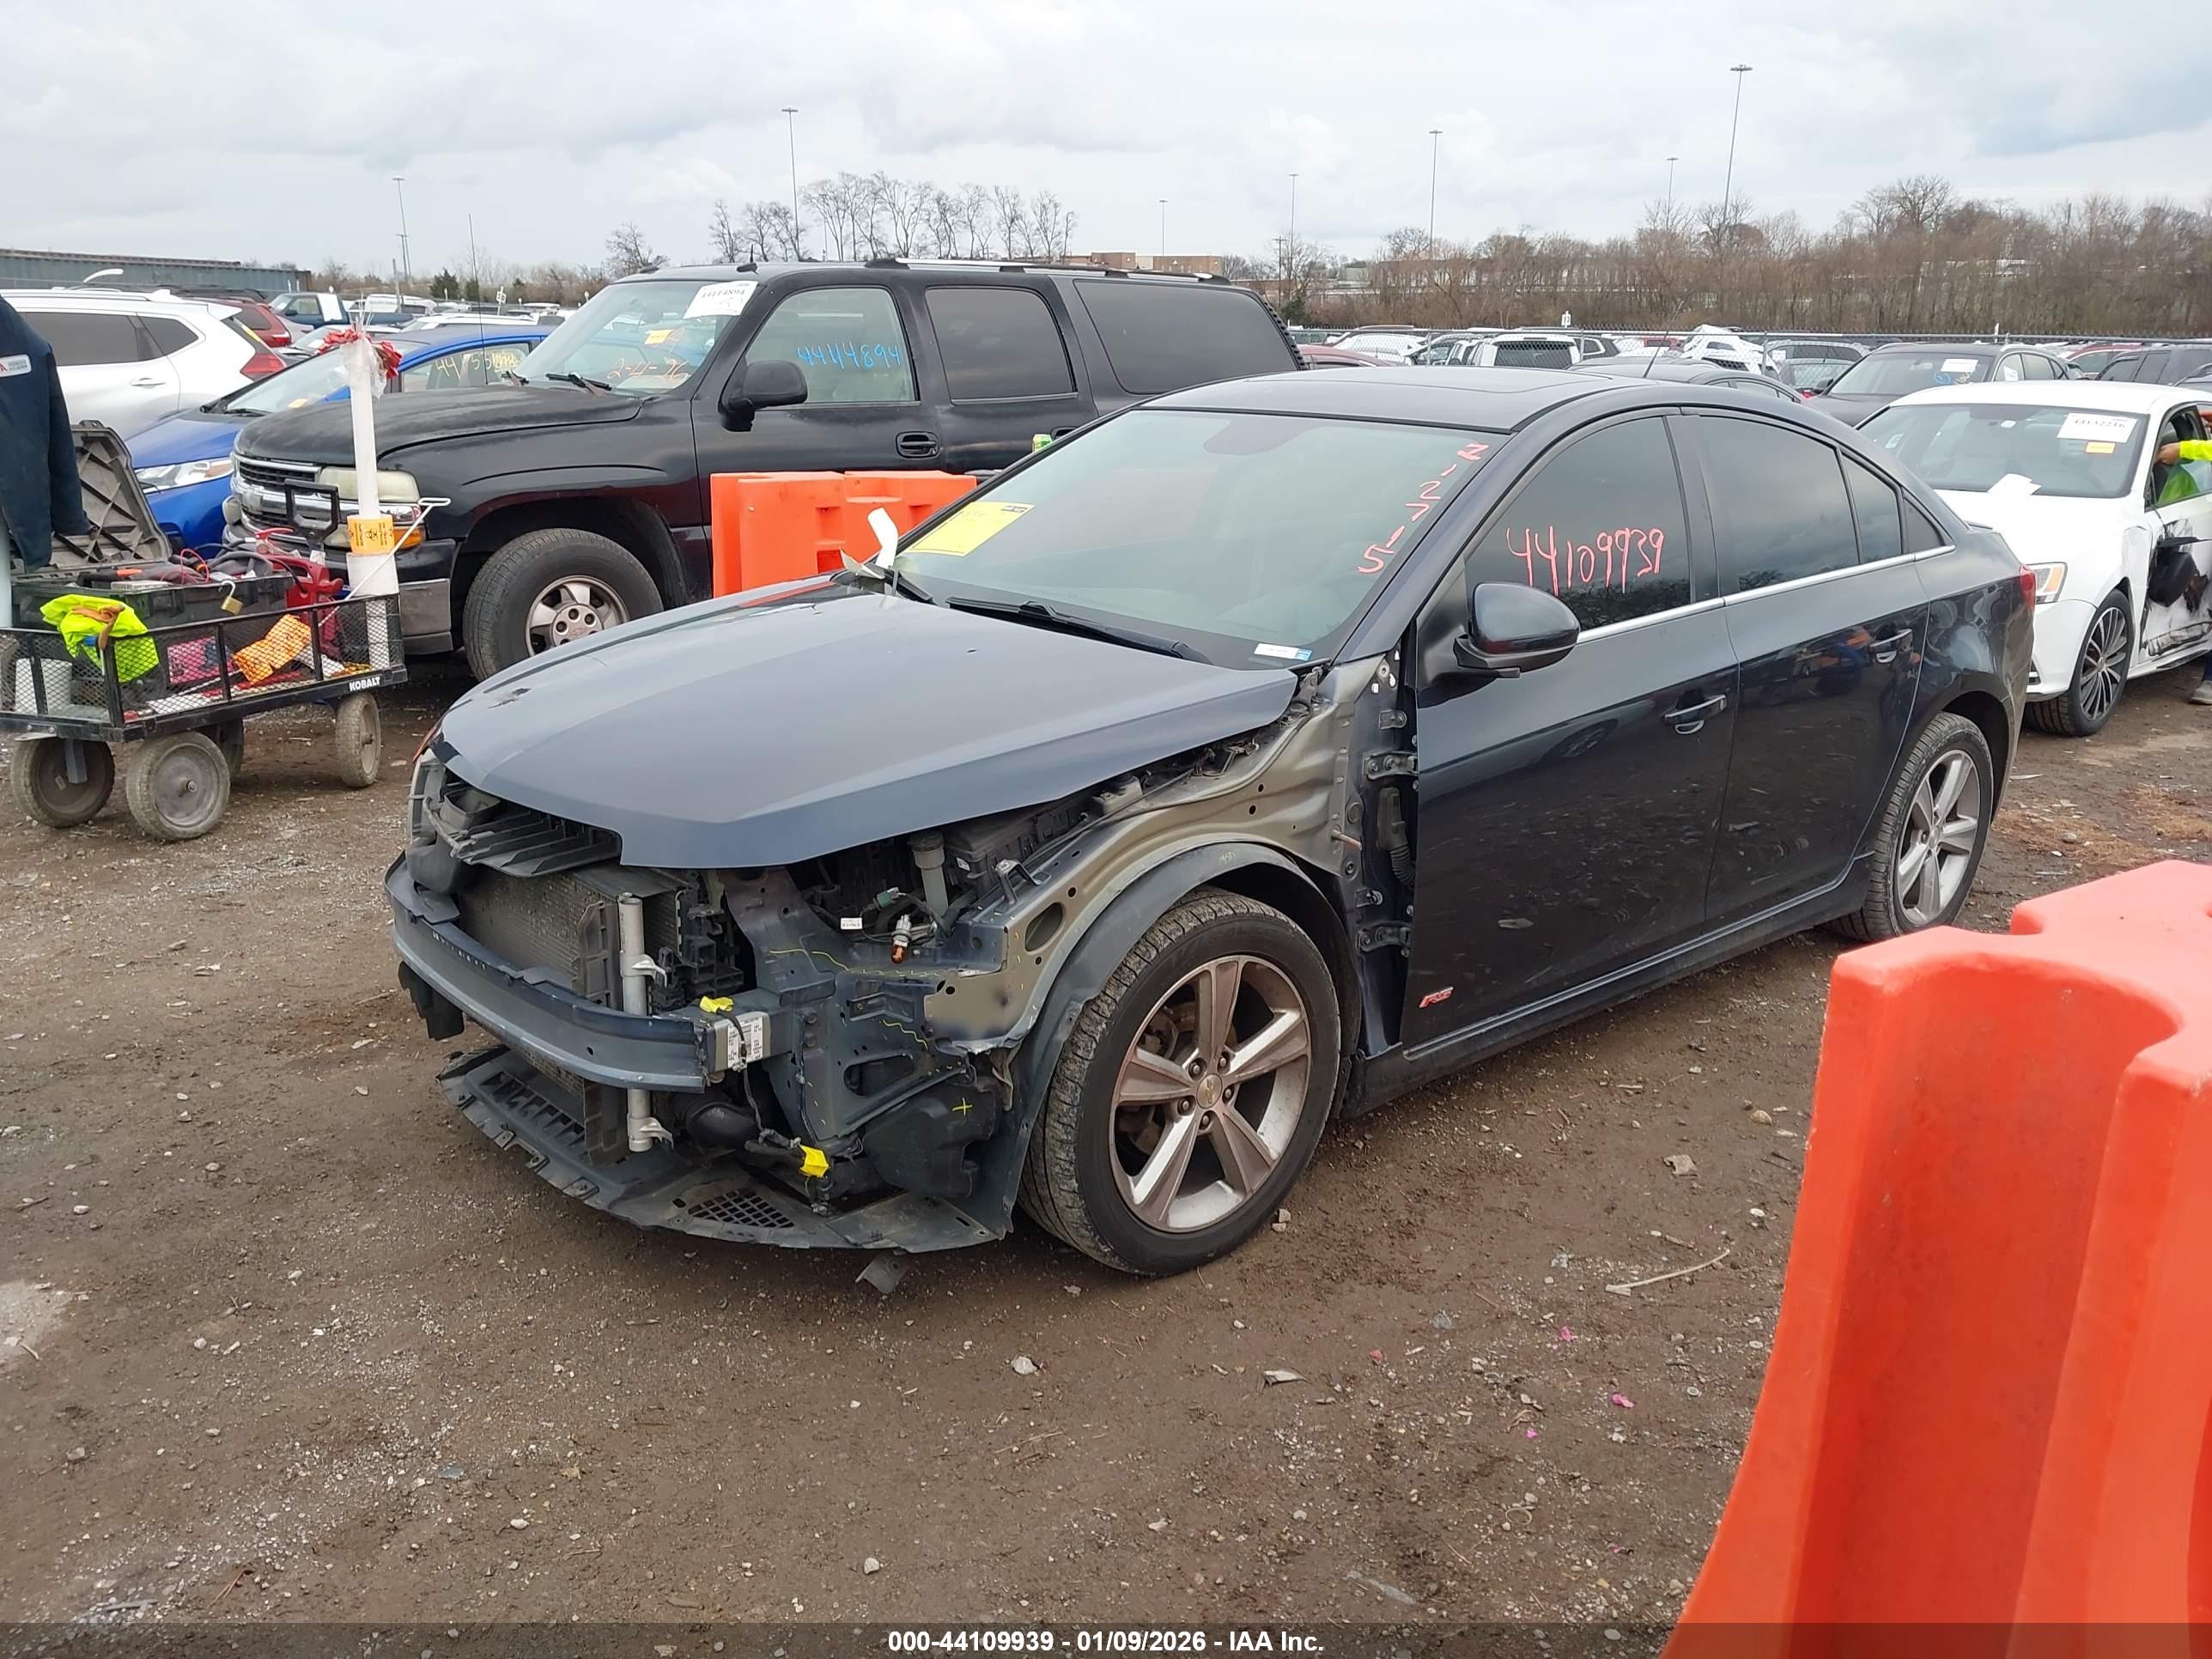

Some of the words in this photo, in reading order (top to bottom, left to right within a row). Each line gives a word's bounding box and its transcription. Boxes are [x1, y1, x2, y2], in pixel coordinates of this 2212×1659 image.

[796, 341, 901, 370] 44114894
[1506, 525, 1664, 598] 44109939
[349, 676, 380, 692] KOBALT
[1419, 987, 1454, 1008] RS
